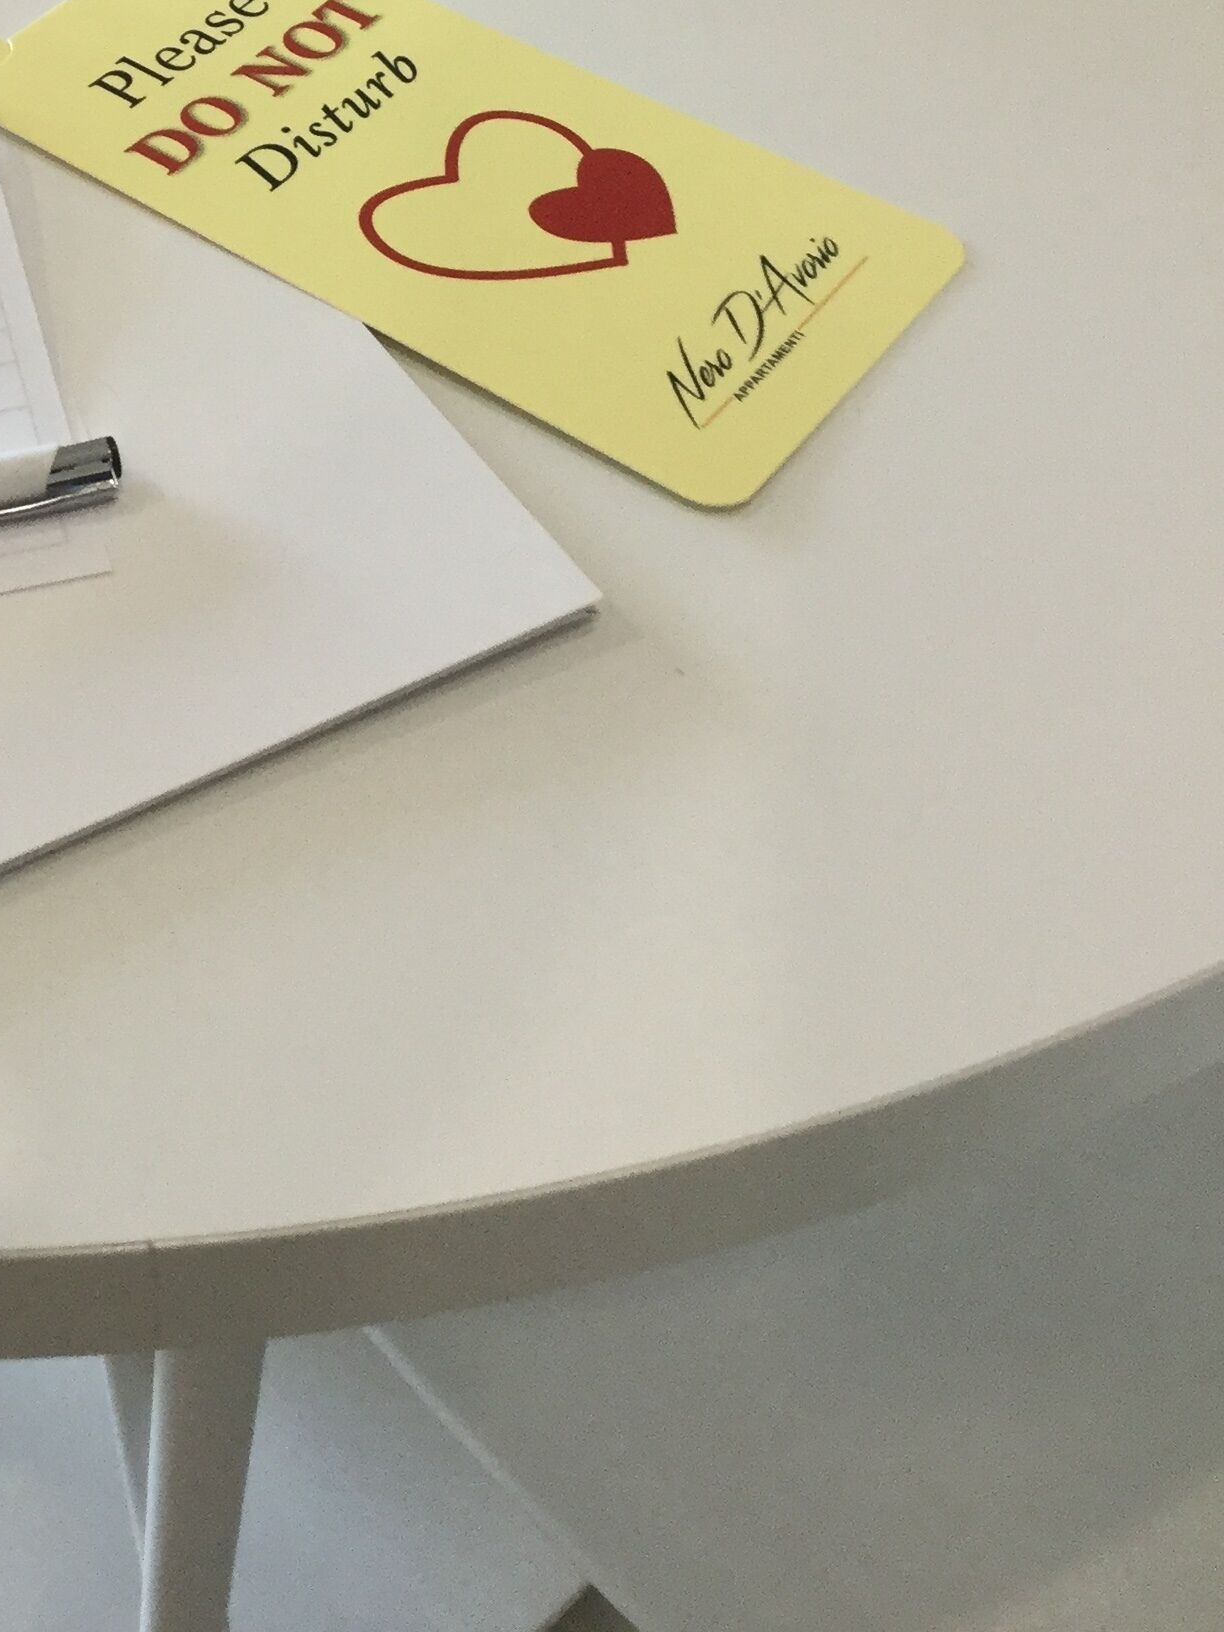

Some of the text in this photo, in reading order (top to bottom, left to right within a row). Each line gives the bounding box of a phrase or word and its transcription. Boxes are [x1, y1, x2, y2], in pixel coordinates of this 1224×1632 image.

[123, 96, 249, 176] DO
[234, 51, 418, 193] Disturb
[666, 237, 840, 430] Nero D'Avorio
[733, 329, 806, 402] APPARTAMENTI
